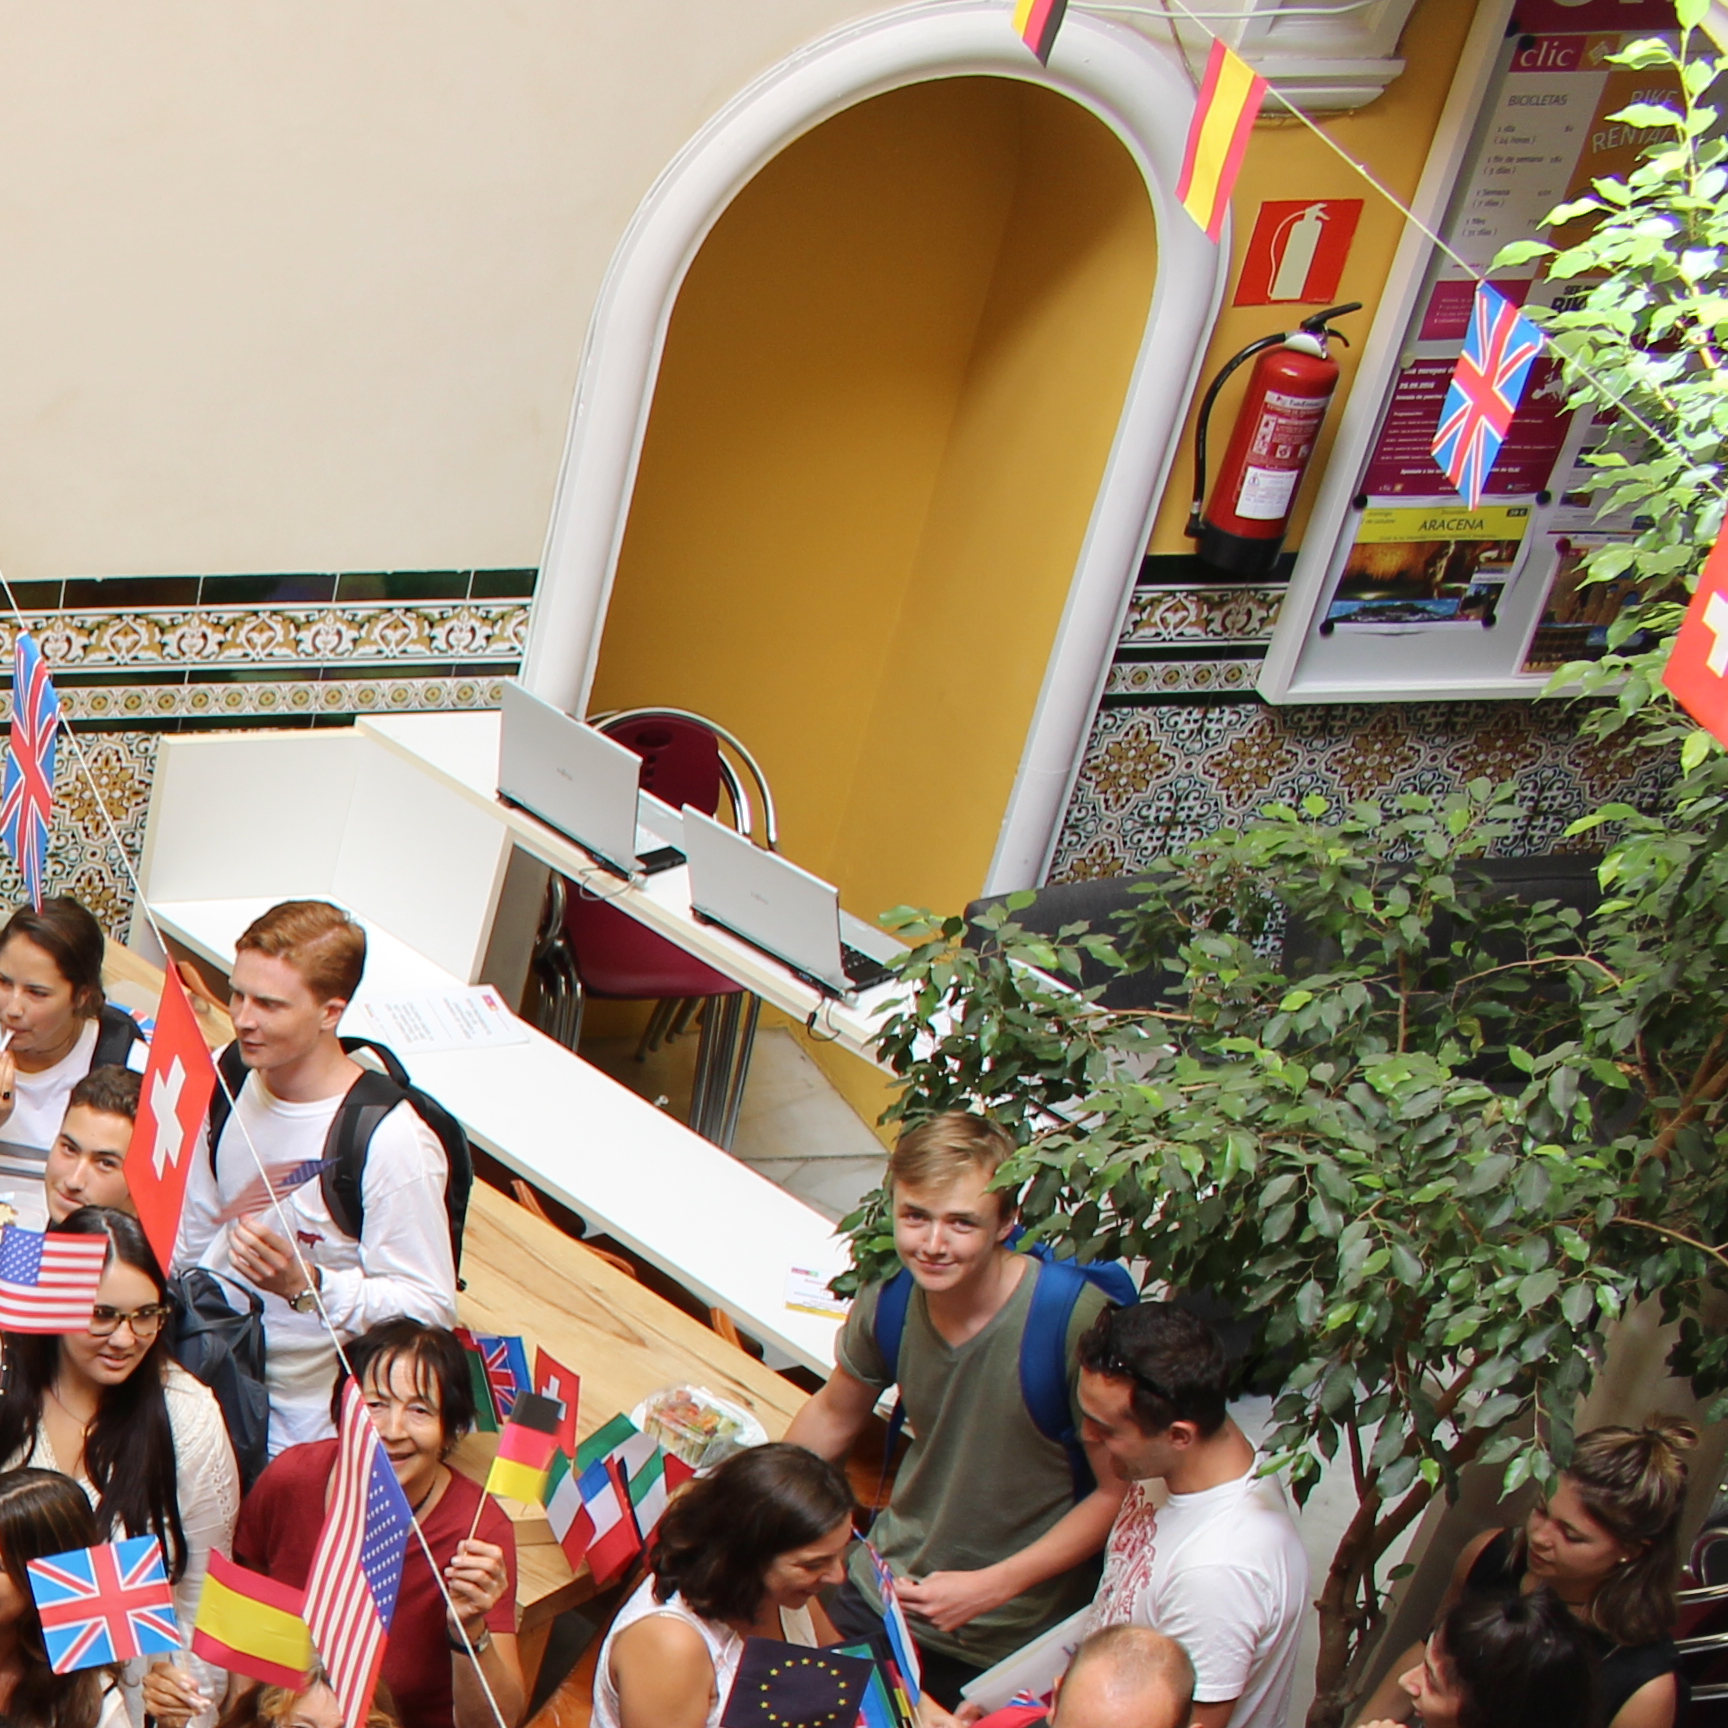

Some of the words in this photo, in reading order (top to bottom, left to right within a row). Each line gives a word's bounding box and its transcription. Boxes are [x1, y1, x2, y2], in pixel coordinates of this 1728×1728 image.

[1519, 41, 1575, 68] clic
[1507, 94, 1568, 106] BICICLETAS
[1419, 519, 1485, 531] ARACENA
